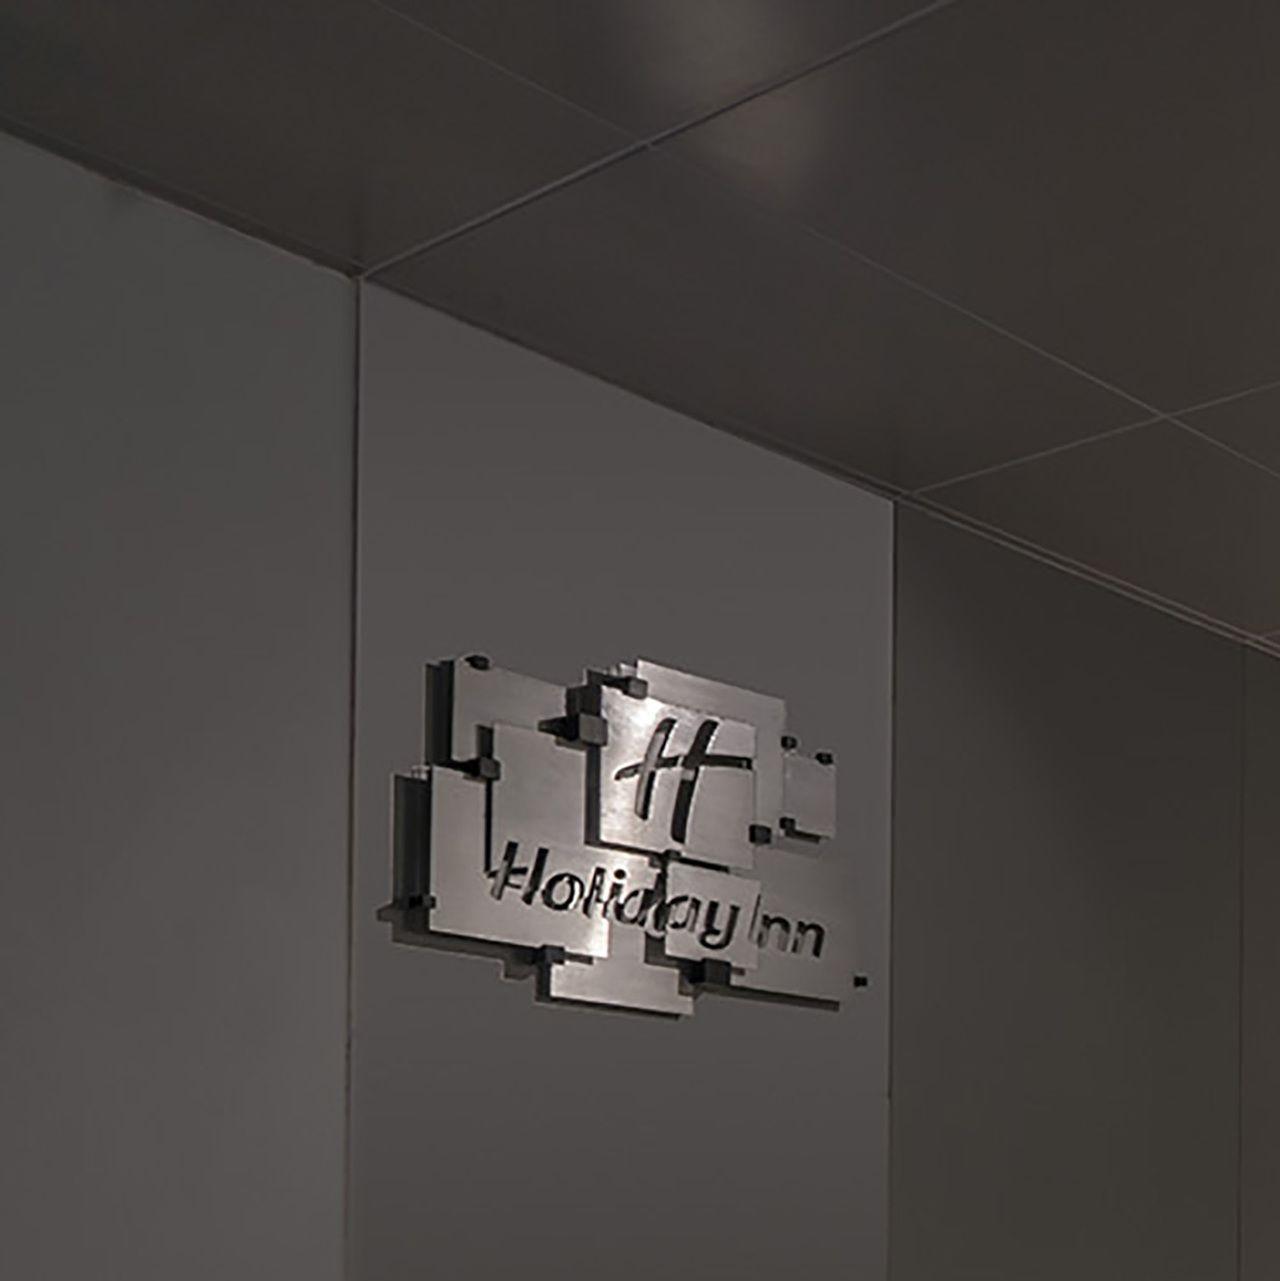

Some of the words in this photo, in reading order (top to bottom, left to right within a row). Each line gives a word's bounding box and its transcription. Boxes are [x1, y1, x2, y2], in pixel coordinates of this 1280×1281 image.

[614, 716, 753, 844] H
[487, 840, 741, 950] Holiday
[754, 893, 826, 958] Inn
